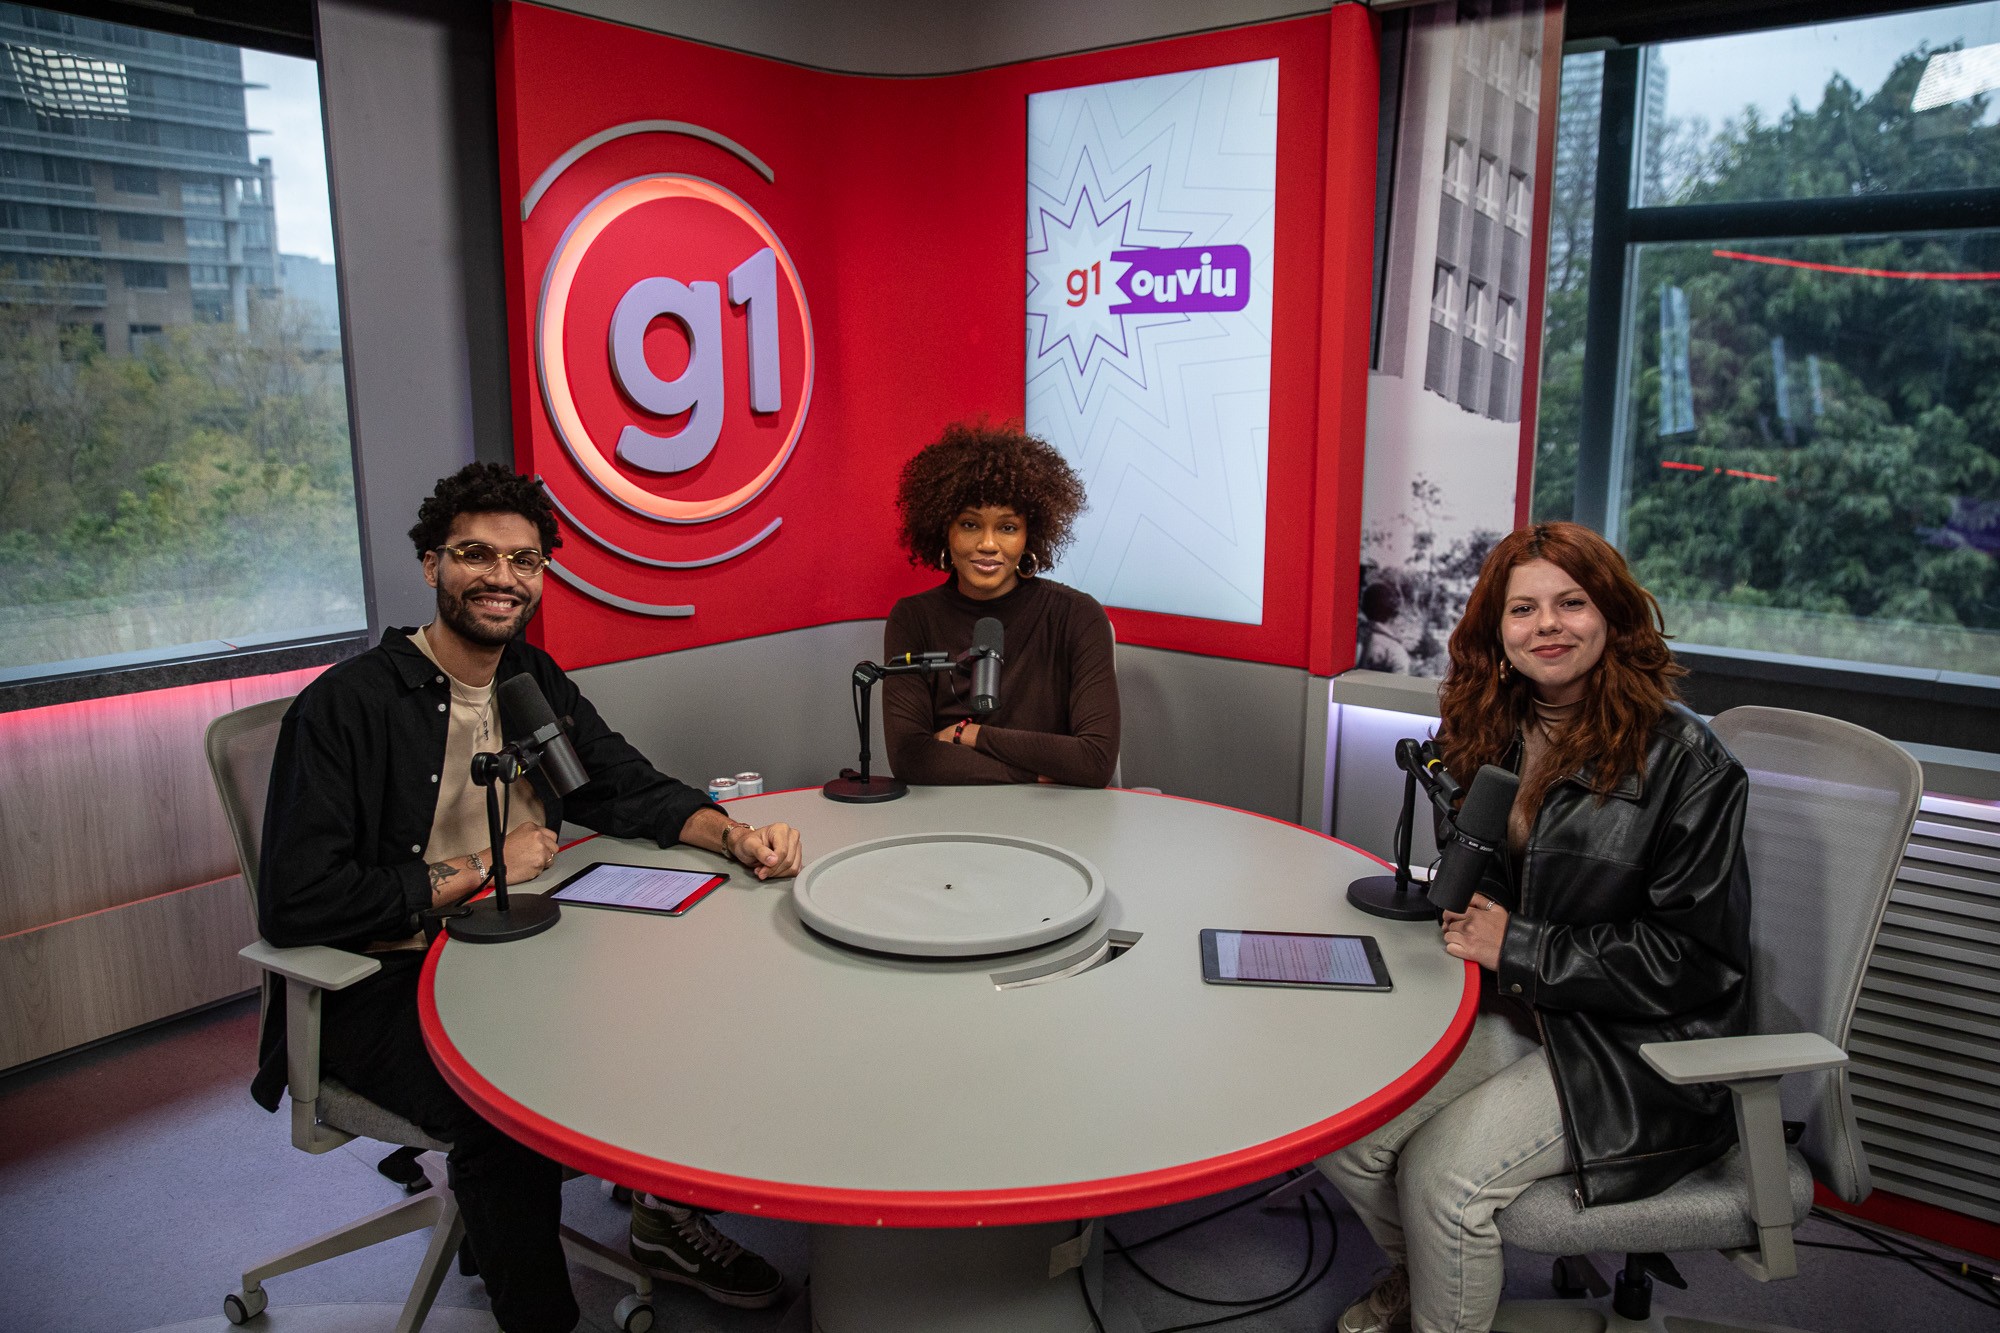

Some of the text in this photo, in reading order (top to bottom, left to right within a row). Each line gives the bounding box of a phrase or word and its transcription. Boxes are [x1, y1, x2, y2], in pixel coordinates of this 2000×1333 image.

[1066, 252, 1237, 307] g1 ouviu
[609, 247, 781, 473] g1
